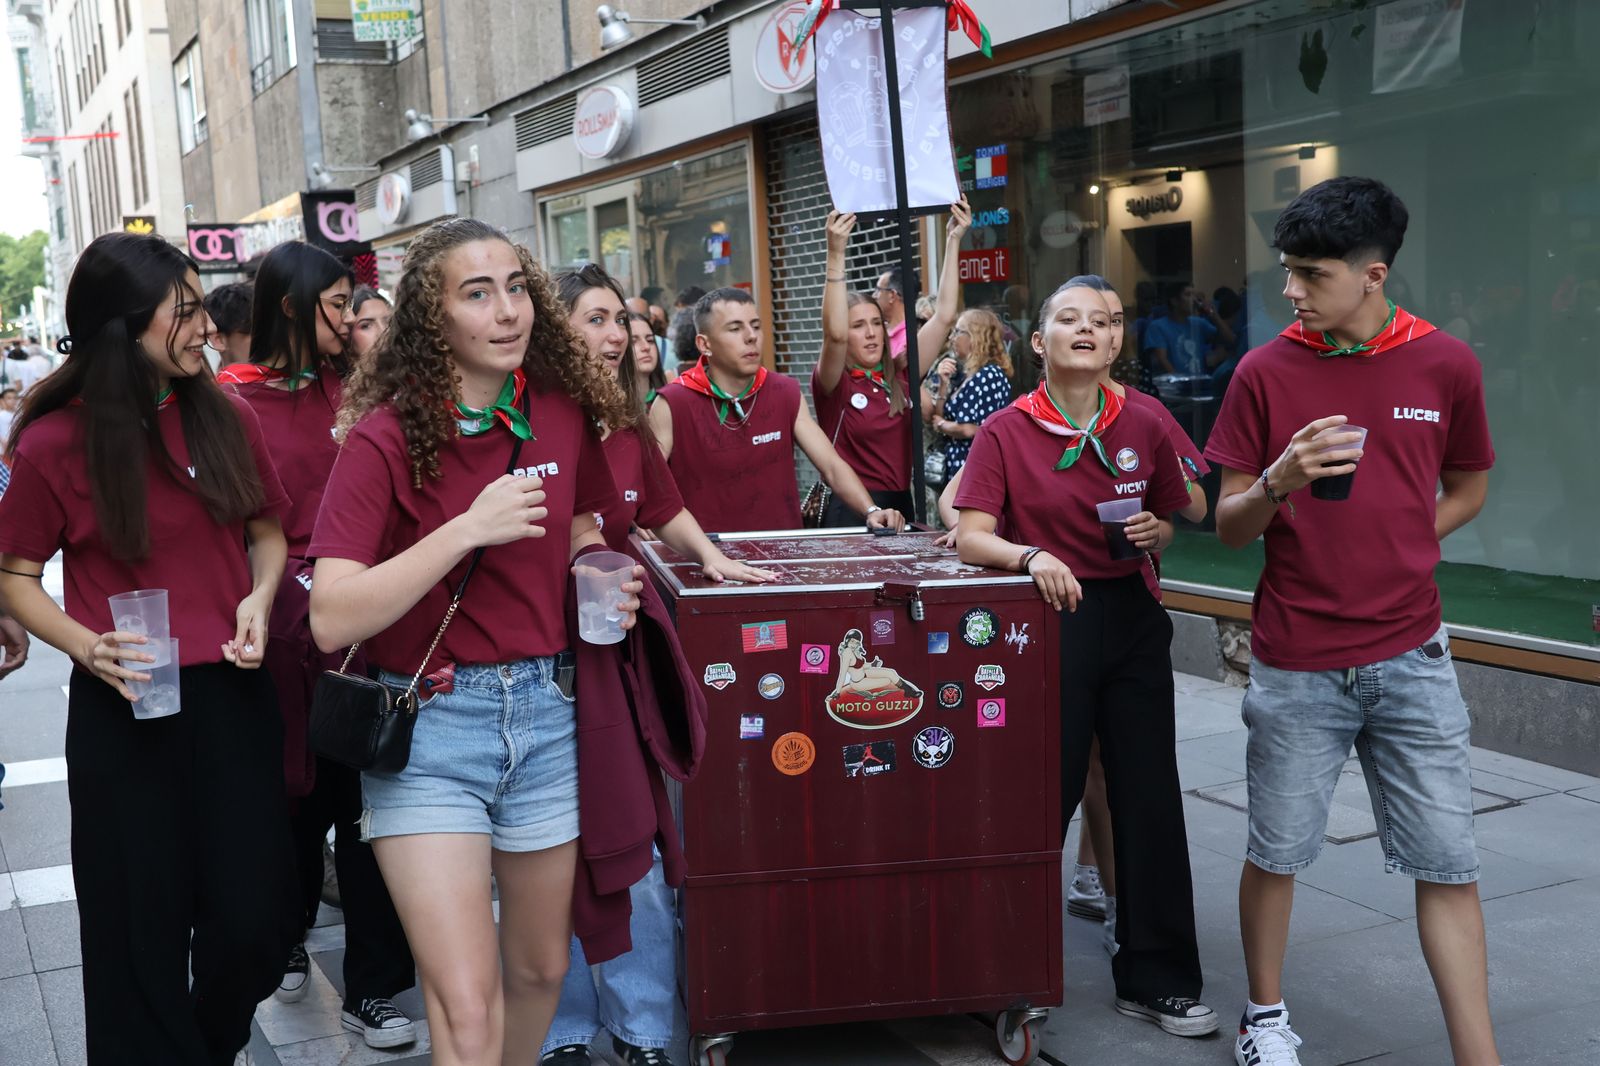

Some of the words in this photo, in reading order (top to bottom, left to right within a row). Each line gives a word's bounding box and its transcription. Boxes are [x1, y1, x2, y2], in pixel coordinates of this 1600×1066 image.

[360, 11, 408, 21] VENDE
[976, 145, 1006, 157] TOMMY
[977, 177, 1006, 188] HILFIGER
[995, 250, 1005, 277] it
[1114, 479, 1148, 495] VICKY
[836, 702, 871, 713] MOTO
[875, 700, 913, 711] GUZZI
[865, 766, 883, 774] DRINK
[884, 763, 891, 771] IT
